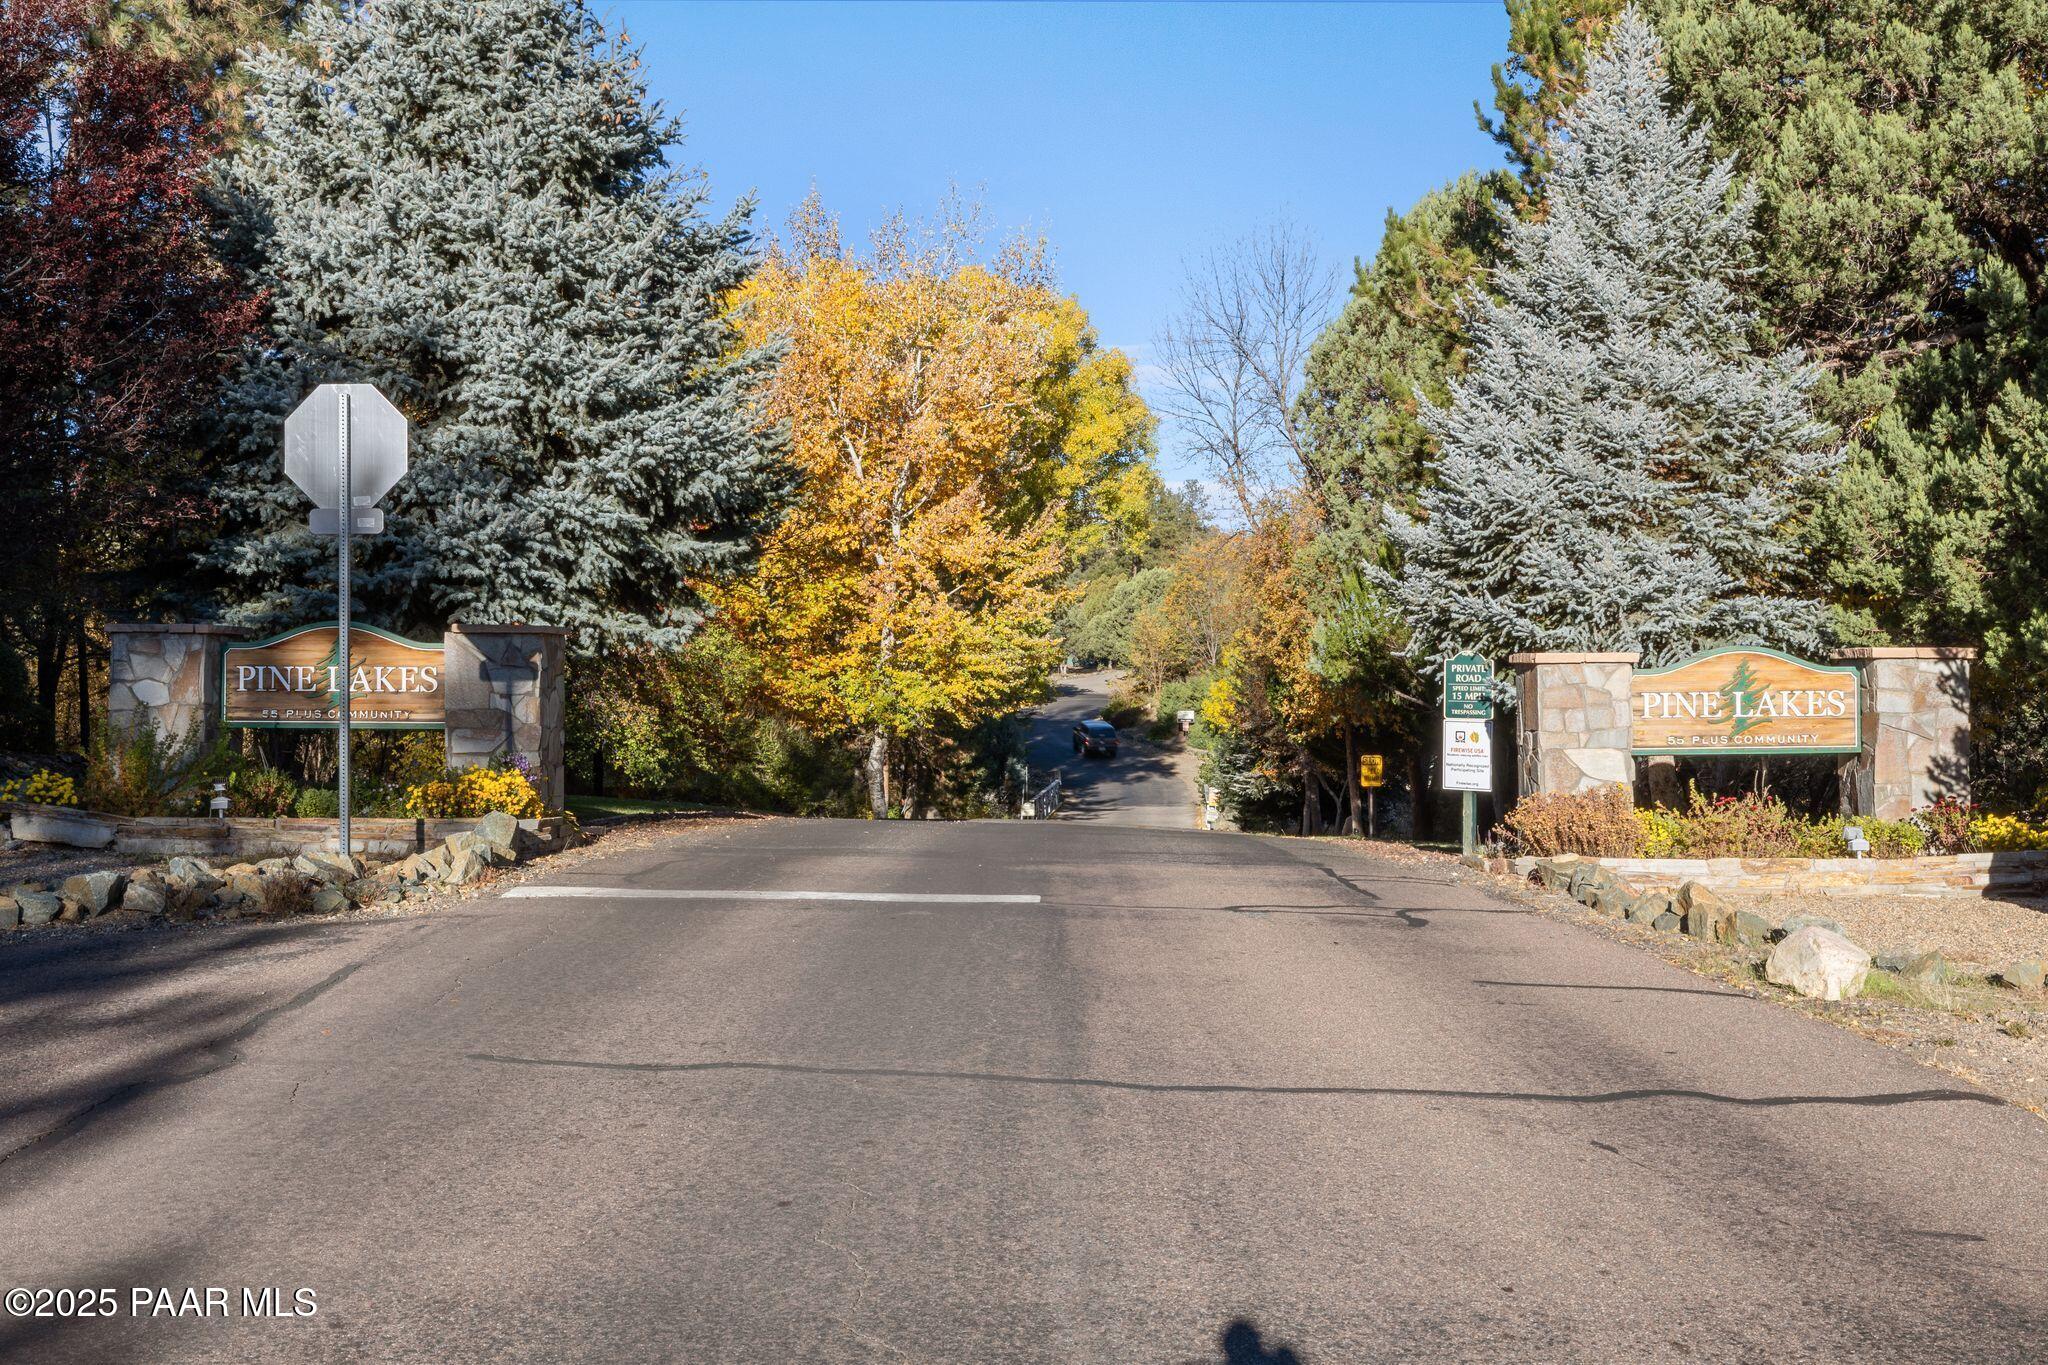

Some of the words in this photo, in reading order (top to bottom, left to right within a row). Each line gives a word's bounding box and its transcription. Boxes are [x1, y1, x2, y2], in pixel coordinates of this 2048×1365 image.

[236, 665, 316, 692] PINE
[1455, 674, 1482, 682] ROAD
[1452, 692, 1462, 700] 15
[1640, 691, 1722, 719] PINE
[1733, 690, 1846, 718] LAKES
[261, 709, 278, 719] 55
[286, 709, 322, 719] PLUS
[327, 709, 411, 719] CMMUNITY
[1667, 736, 1685, 746] 55
[1692, 735, 1728, 745] PLUS
[1734, 734, 1819, 744] COMMUNITY
